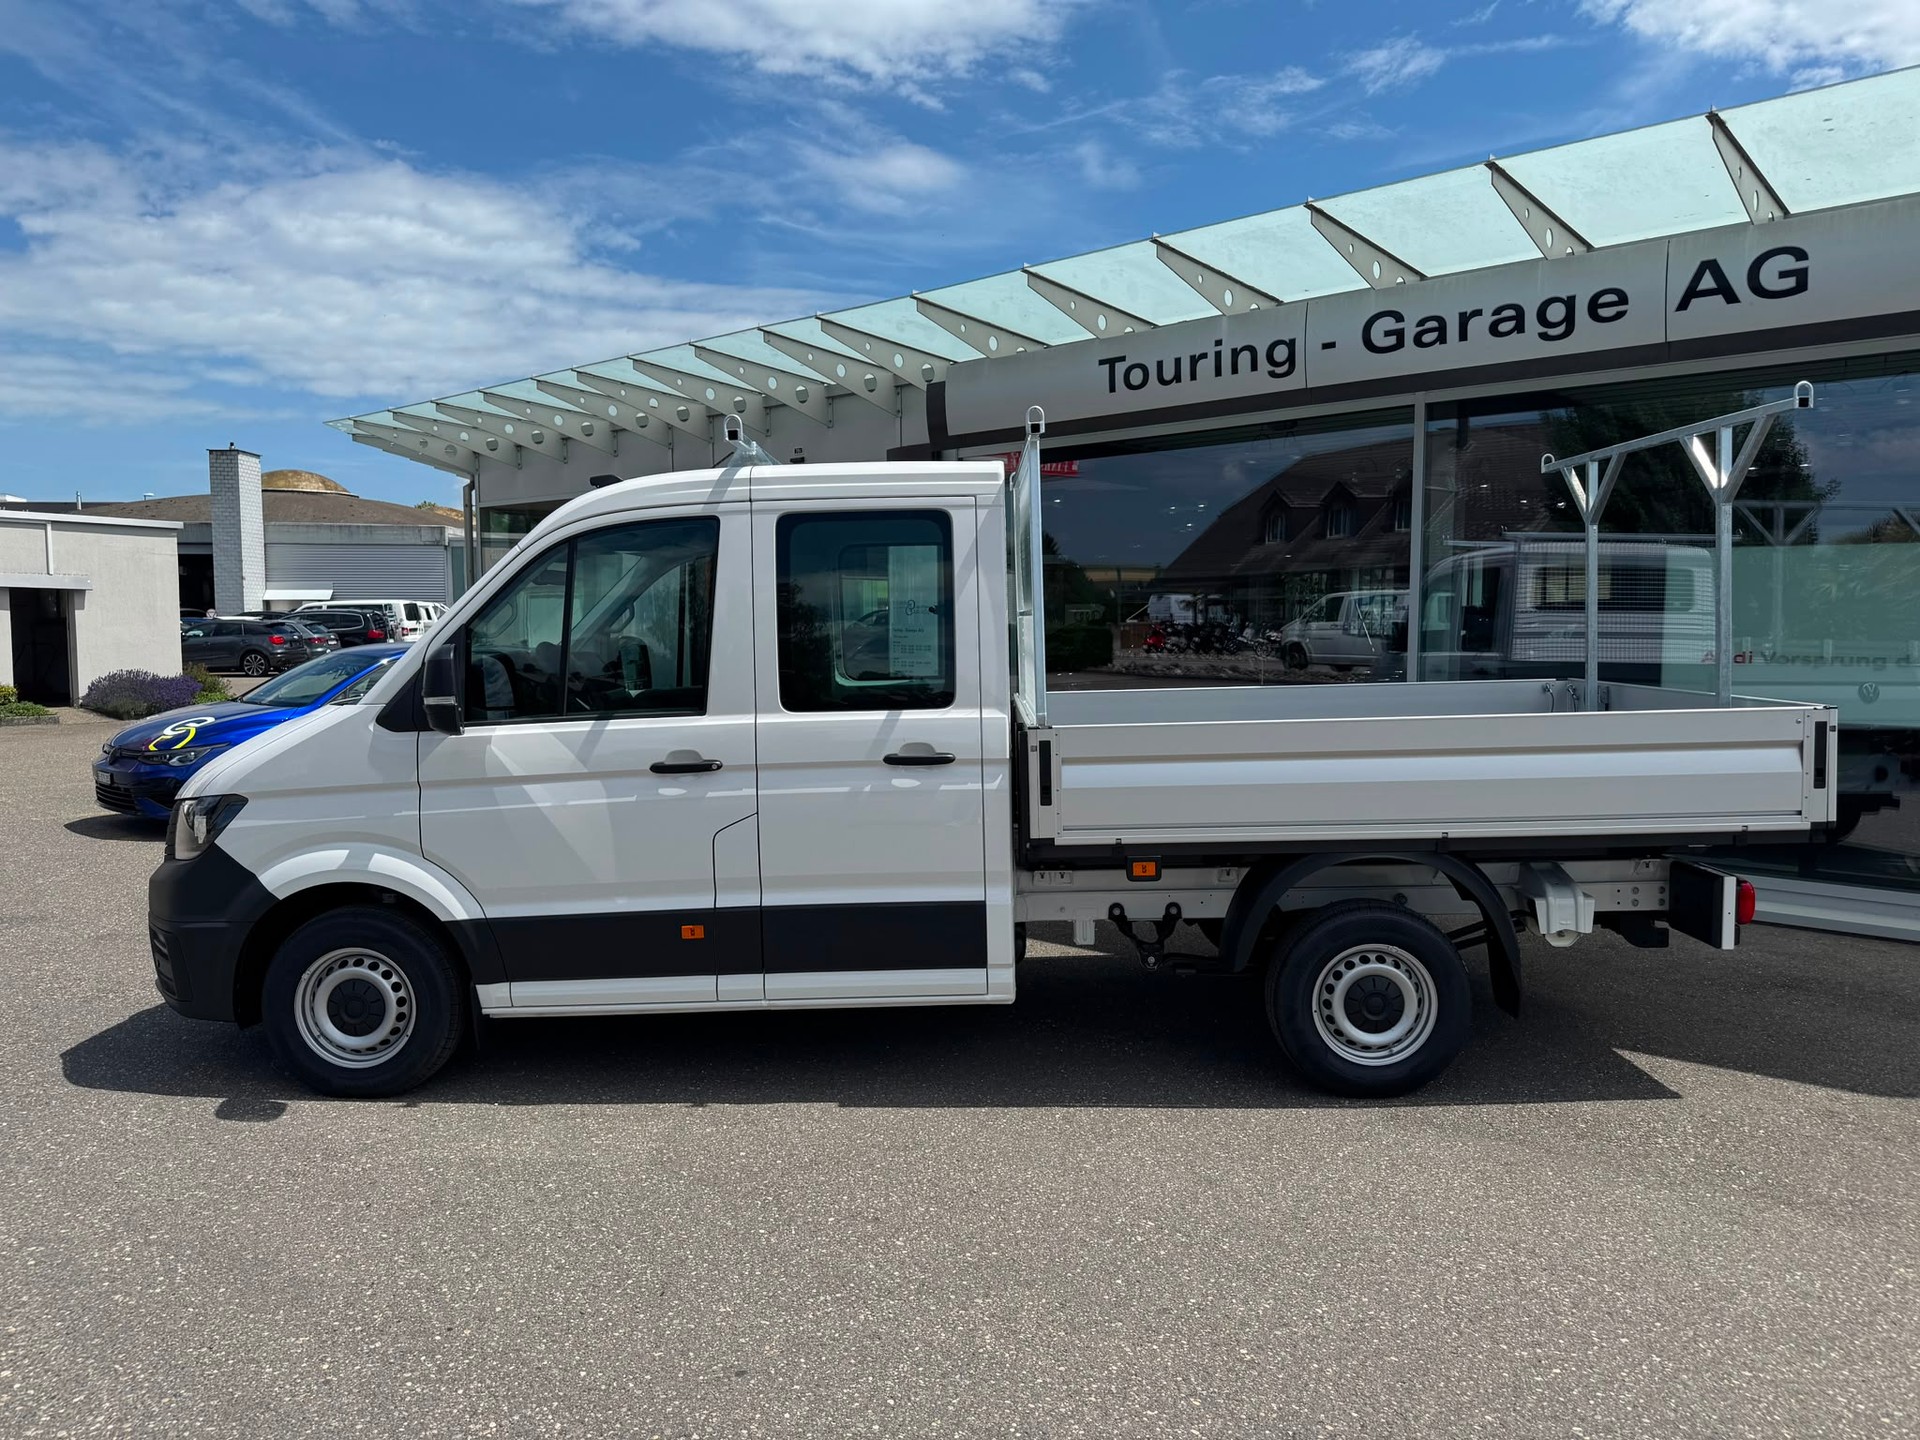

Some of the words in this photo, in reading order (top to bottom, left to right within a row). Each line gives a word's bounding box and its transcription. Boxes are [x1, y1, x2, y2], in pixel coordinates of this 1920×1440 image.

[1098, 336, 1298, 395] Touring
[1361, 287, 1630, 356] Garage
[1674, 246, 1811, 313] AG
[1701, 650, 1753, 665] Adi
